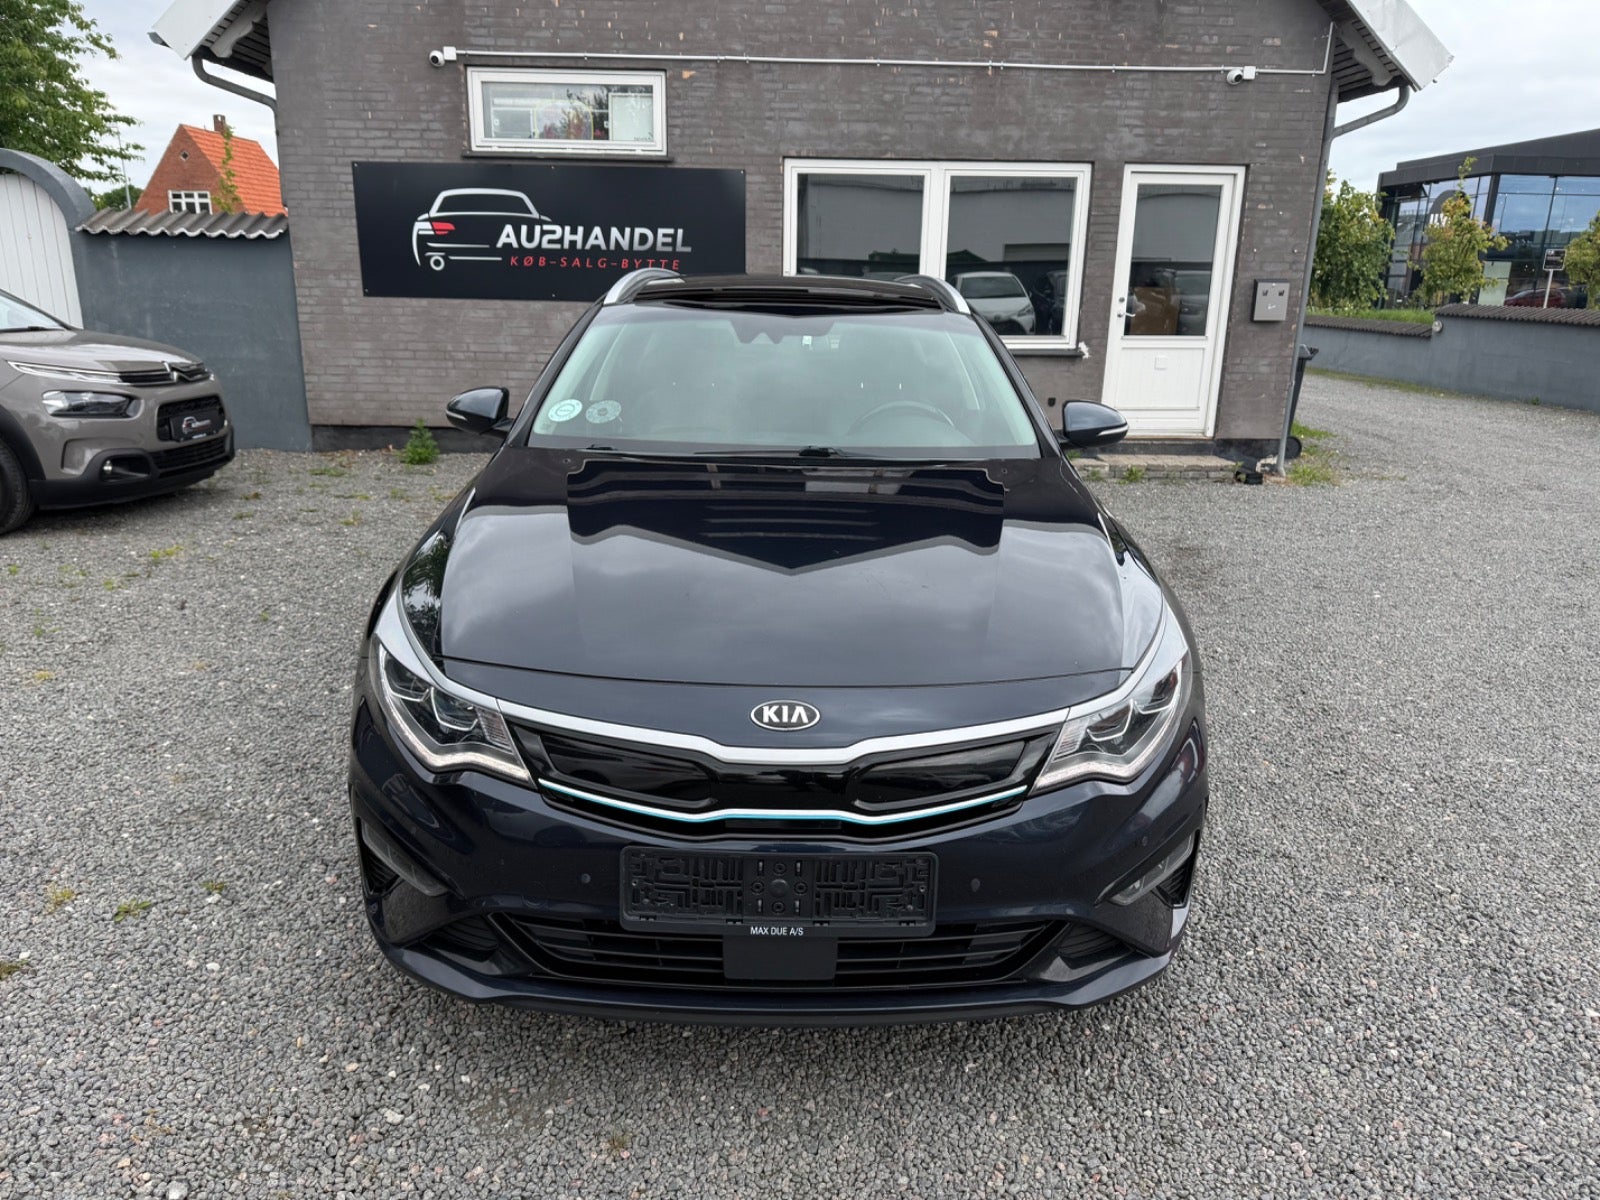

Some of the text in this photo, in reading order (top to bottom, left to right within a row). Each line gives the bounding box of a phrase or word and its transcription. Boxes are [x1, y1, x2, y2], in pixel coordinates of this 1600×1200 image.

[762, 705, 809, 723] KIA
[750, 926, 804, 937] MAX DUE A/S
